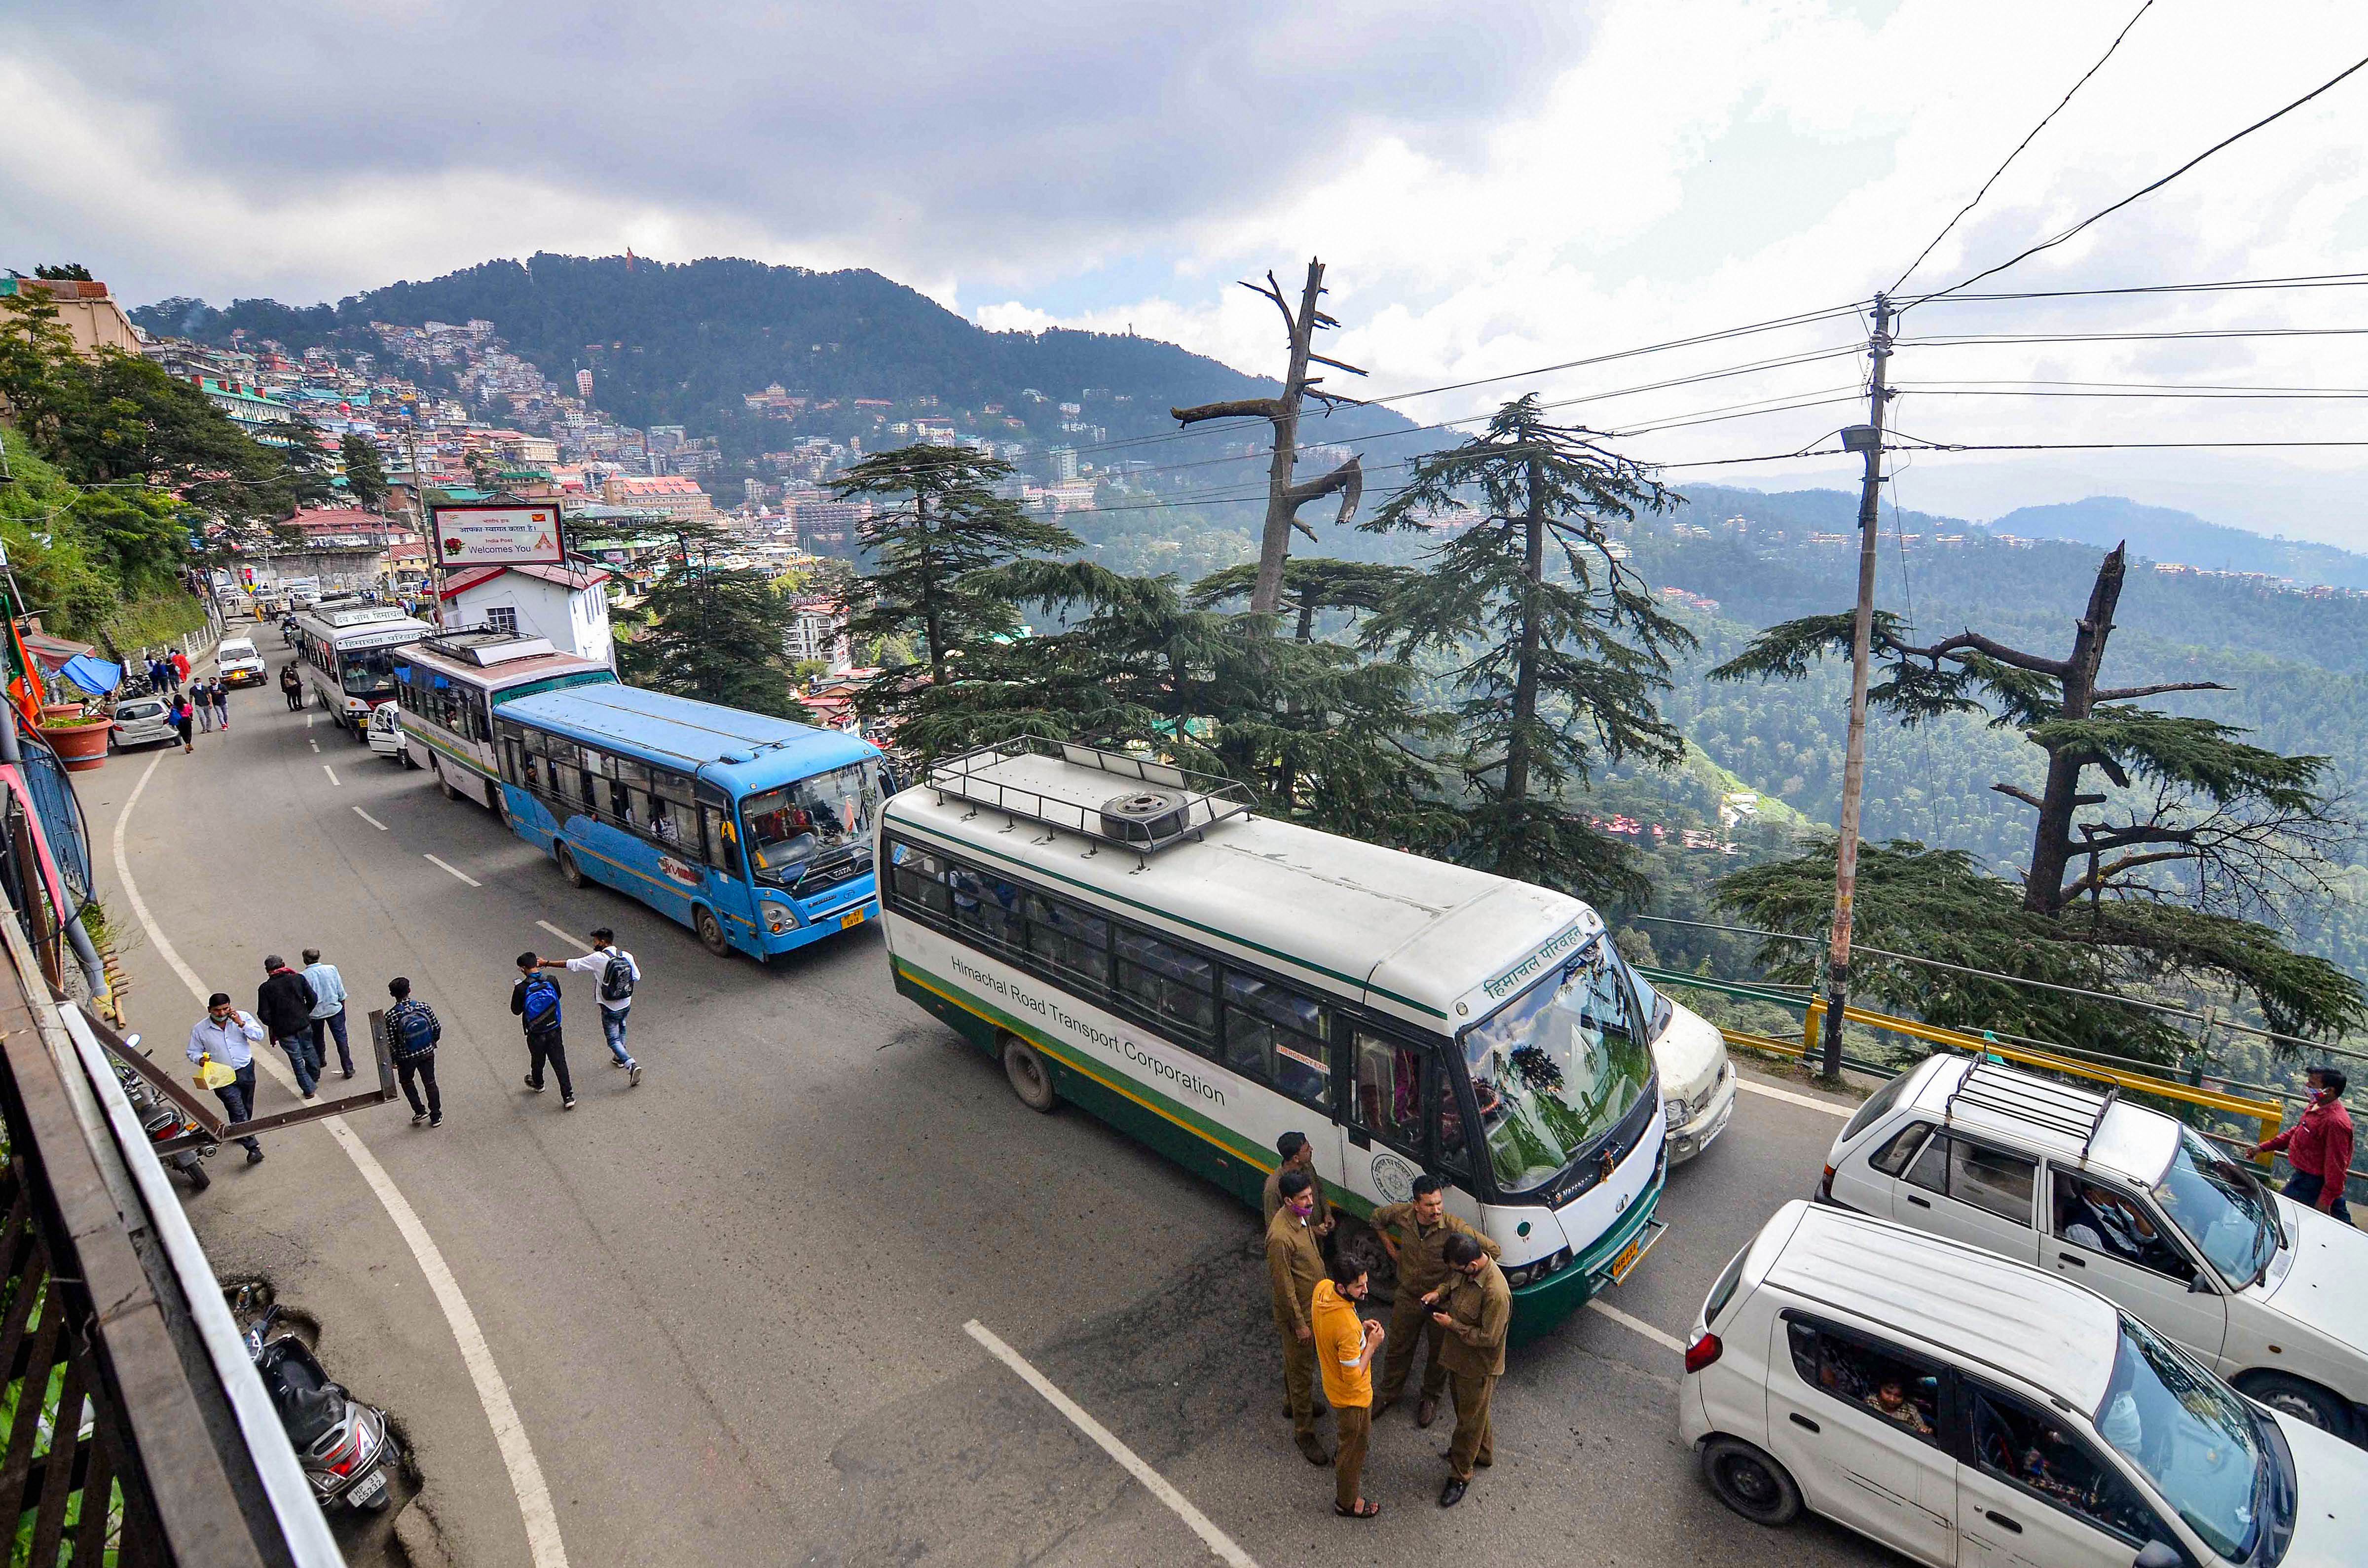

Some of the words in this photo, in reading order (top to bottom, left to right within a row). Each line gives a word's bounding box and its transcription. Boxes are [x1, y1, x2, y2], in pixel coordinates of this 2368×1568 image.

[468, 546, 513, 554] Welcomes
[345, 638, 383, 648] हिमाचल
[833, 866, 851, 877] TATA
[1483, 955, 1541, 999] हिमाचल
[1538, 925, 1583, 959] परिवहन
[951, 956, 1007, 995] Himachal
[1010, 985, 1046, 1016] Road
[1049, 1003, 1120, 1054] Transport
[1124, 1041, 1226, 1106] Corporation
[1278, 1045, 1313, 1065] EMERGENCY
[1314, 1061, 1327, 1071] EXIT
[354, 1486, 363, 1496] HP
[368, 1474, 378, 1484] 31
[359, 1479, 382, 1501] C5232
